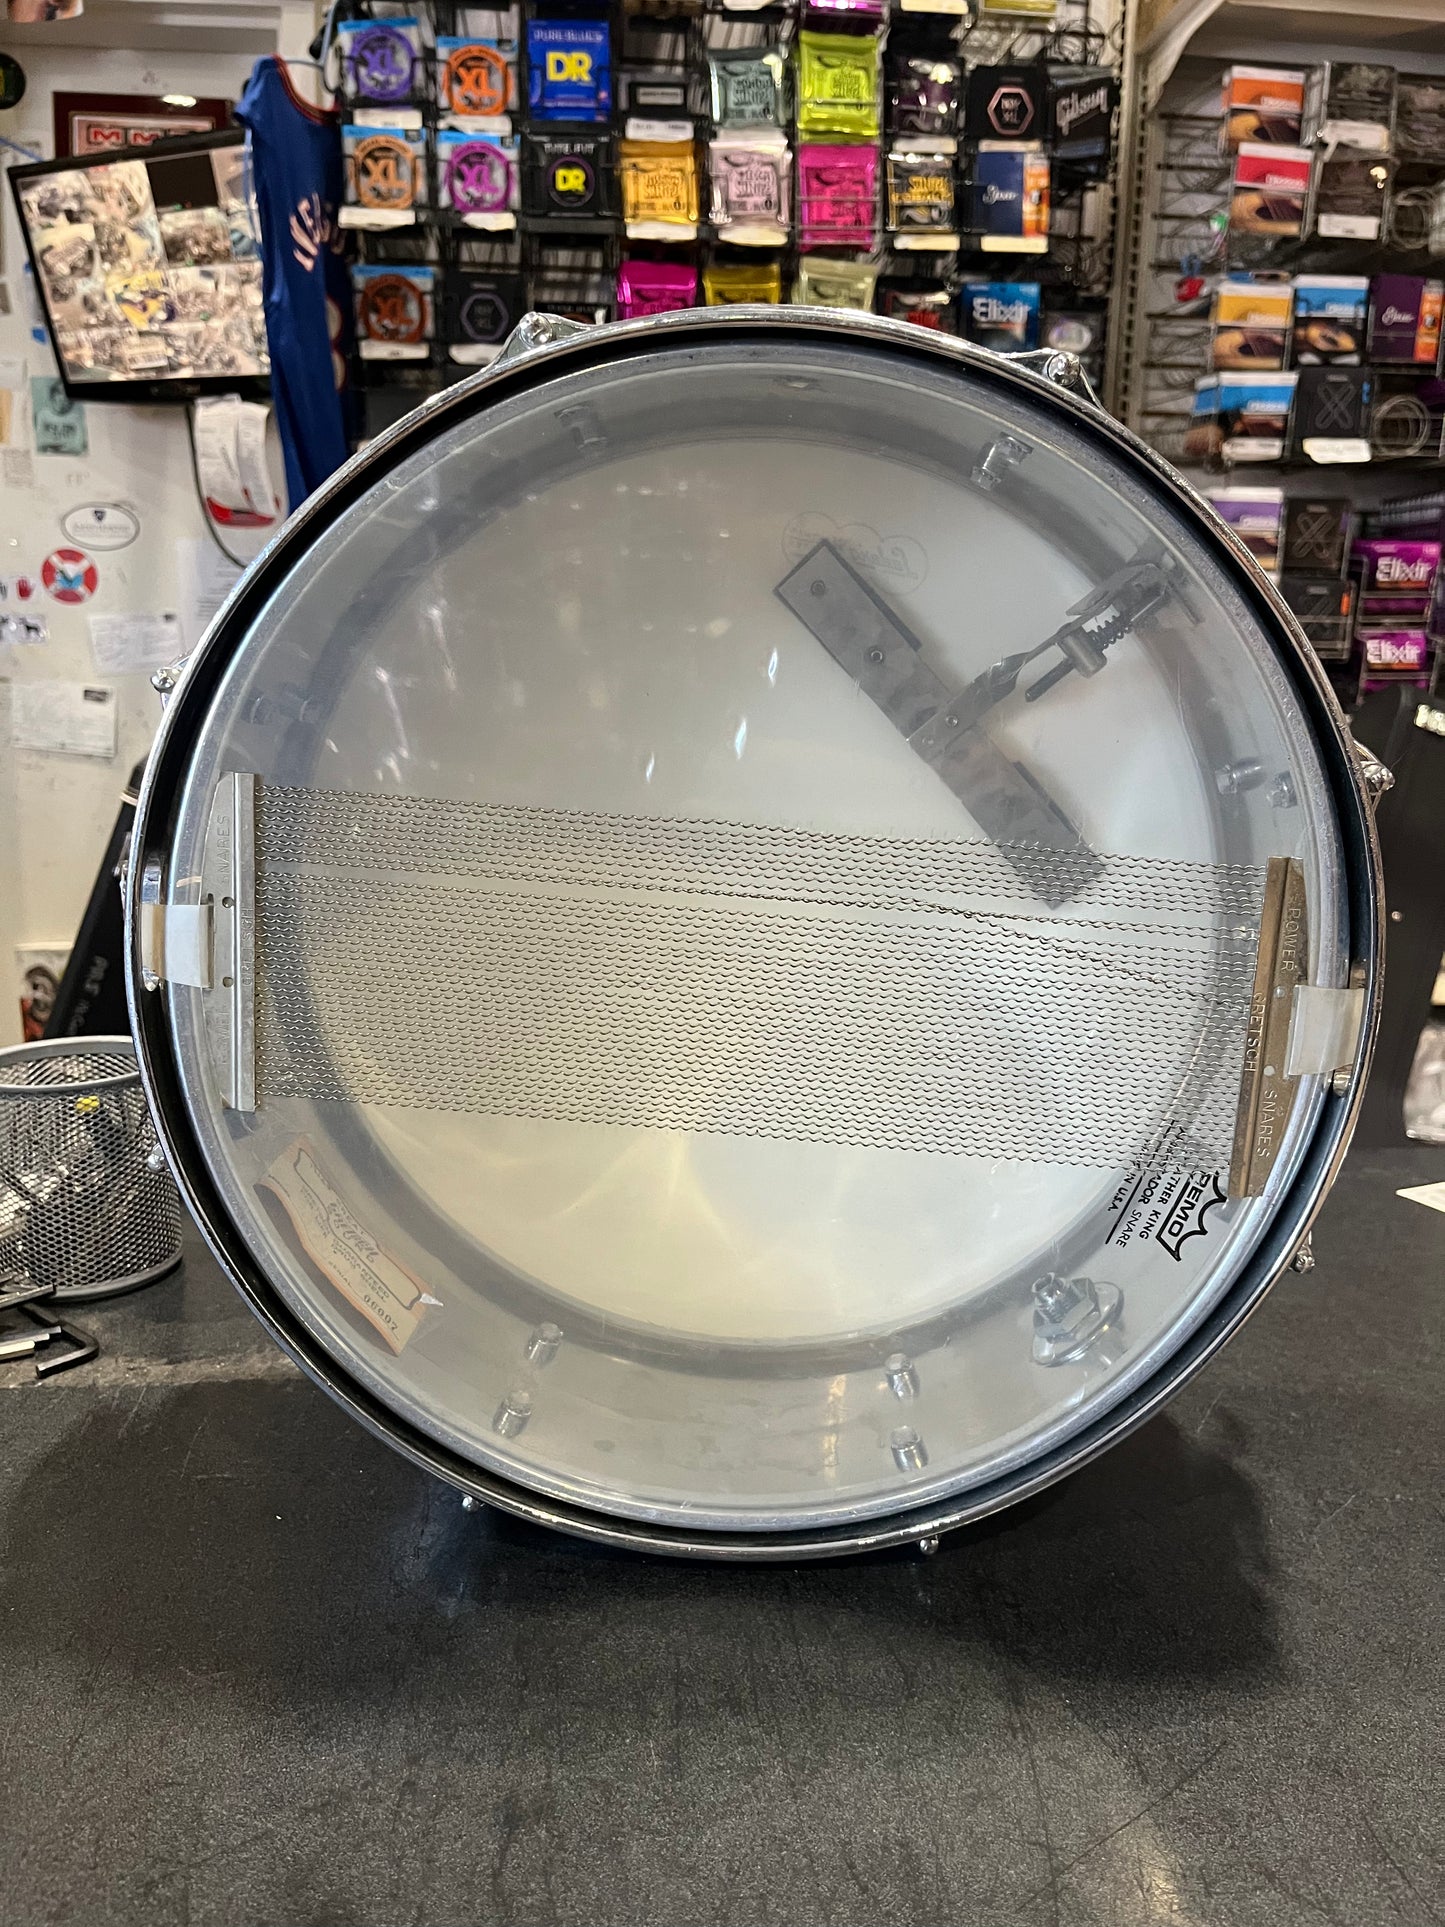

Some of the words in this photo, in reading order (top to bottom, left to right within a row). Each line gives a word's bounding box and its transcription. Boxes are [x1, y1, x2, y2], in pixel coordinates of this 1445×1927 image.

[457, 66, 498, 97] XL
[546, 51, 592, 82] DR
[1056, 87, 1108, 136] Gibson
[364, 157, 407, 189] XL
[460, 164, 499, 195] XL
[555, 167, 587, 194] DR
[972, 296, 1032, 323] Elixir
[1376, 556, 1432, 582] Elixir
[1366, 638, 1420, 664] Elixir
[1281, 907, 1301, 973] POWER
[1244, 991, 1267, 1073] GRETSCH
[1257, 1089, 1278, 1158] SNARES
[1124, 1171, 1137, 1184] IN
[1107, 1186, 1129, 1211] U.S.A.
[1116, 1209, 1142, 1248] SNARE
[1139, 1209, 1162, 1240] KING
